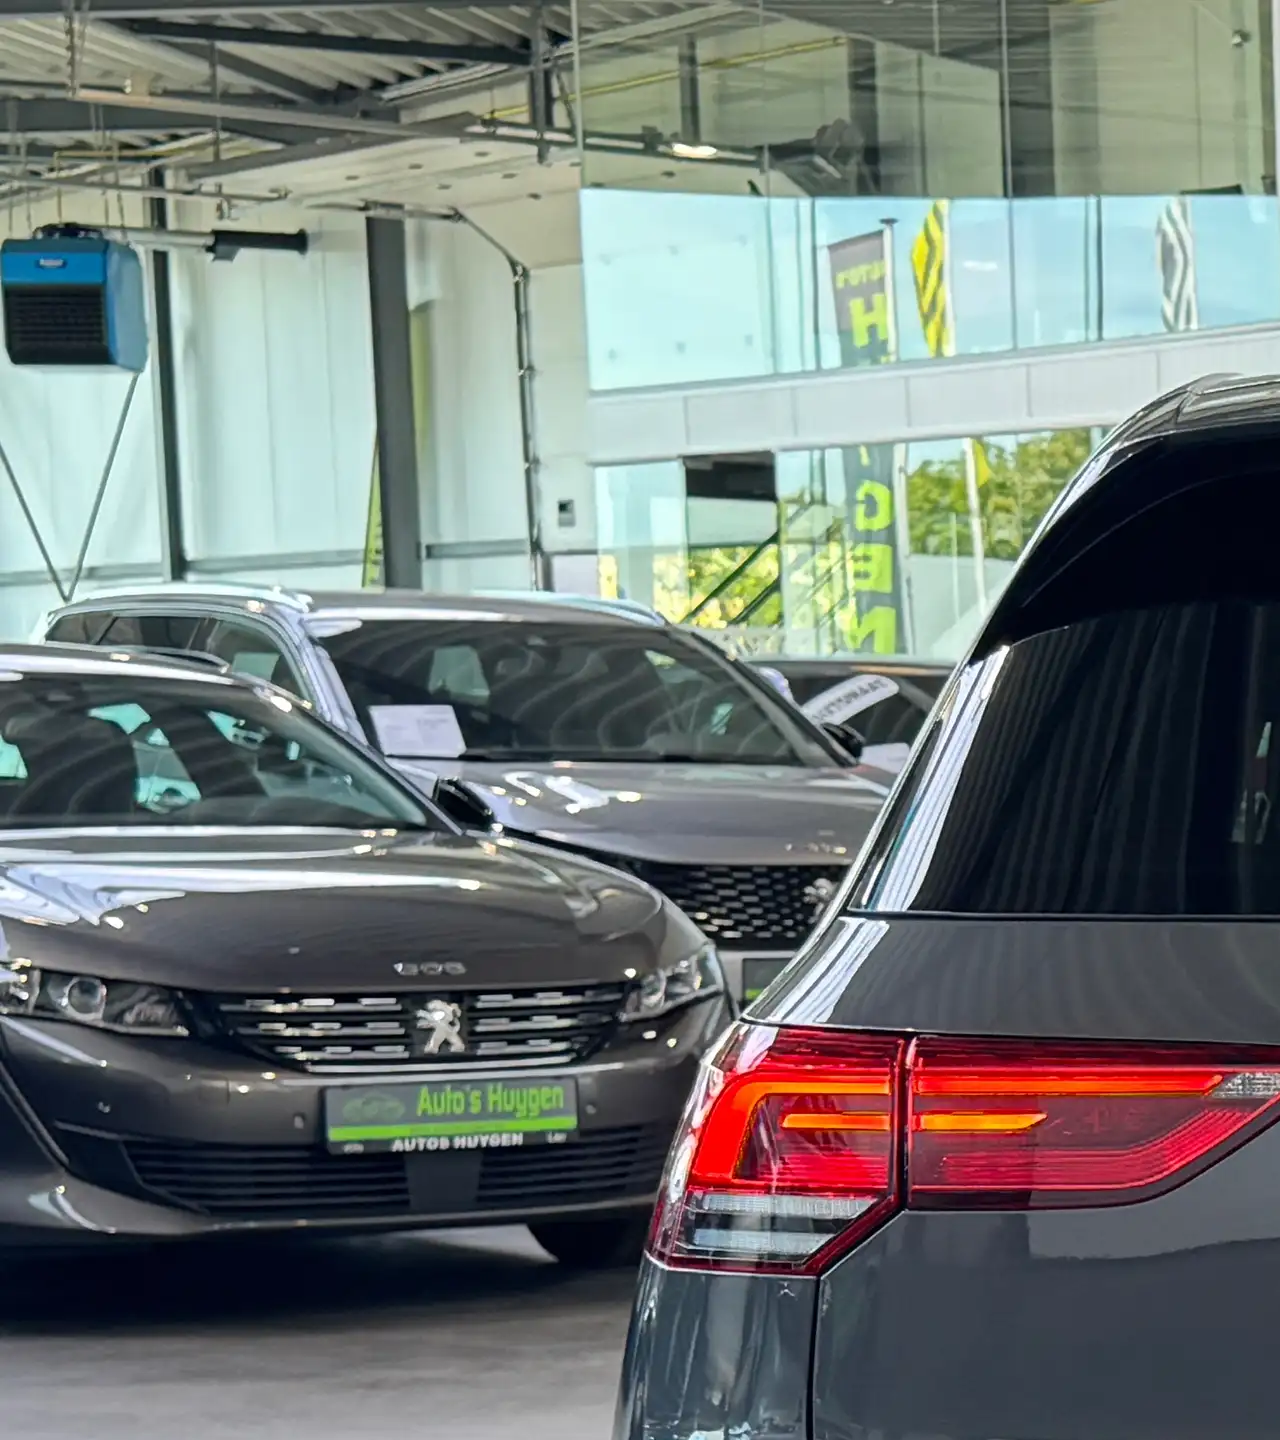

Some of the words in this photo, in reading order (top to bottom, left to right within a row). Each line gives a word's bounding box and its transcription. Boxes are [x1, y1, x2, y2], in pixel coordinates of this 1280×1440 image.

[417, 1084, 482, 1116] Auto's
[489, 1082, 564, 1118] Huygen
[453, 1133, 523, 1149] HUYGEN
